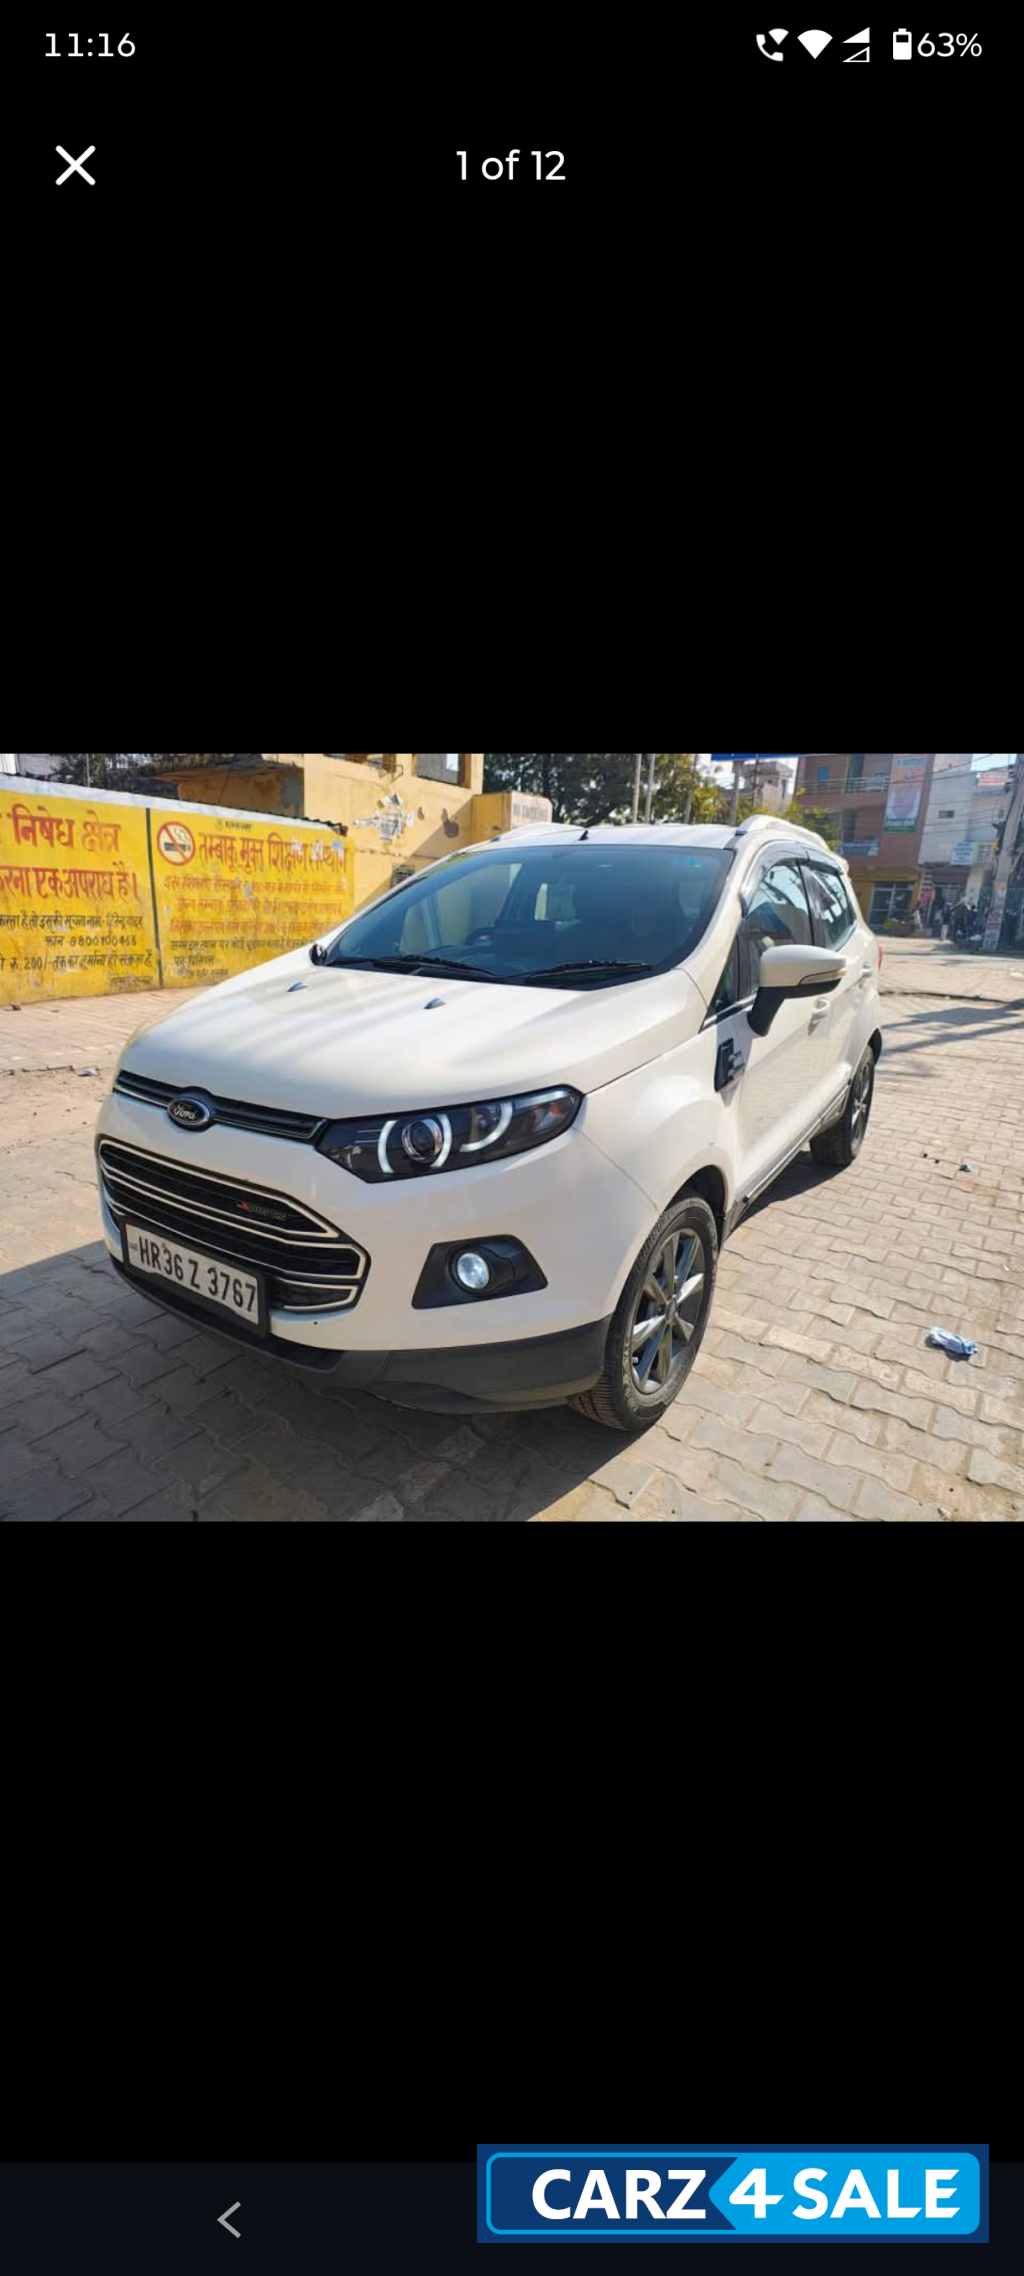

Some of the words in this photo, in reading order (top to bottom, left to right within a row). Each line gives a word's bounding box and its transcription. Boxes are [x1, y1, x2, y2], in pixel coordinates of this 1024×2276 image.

[8, 803, 75, 848] निषेध
[82, 809, 121, 854] क्षेत्र
[173, 1103, 198, 1120] Ford
[138, 1236, 184, 1281] HR36
[188, 1259, 200, 1290] Z
[207, 1265, 257, 1312] 3767
